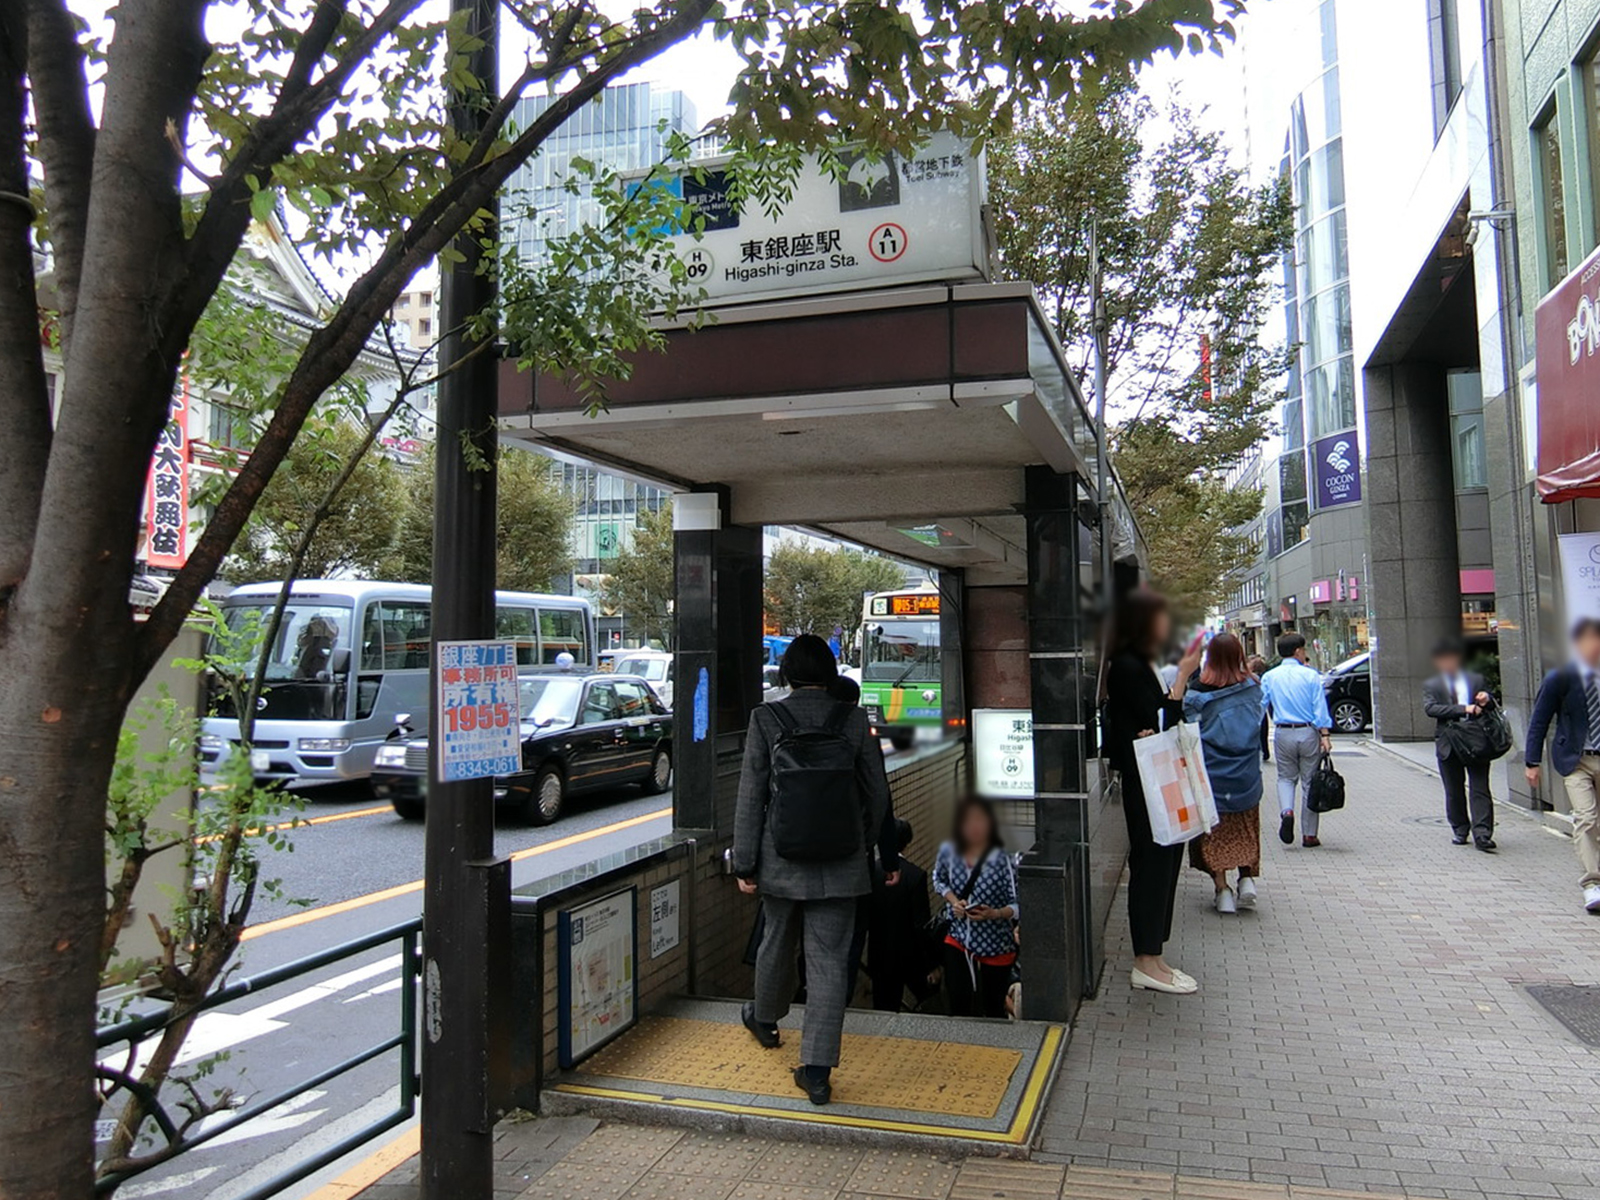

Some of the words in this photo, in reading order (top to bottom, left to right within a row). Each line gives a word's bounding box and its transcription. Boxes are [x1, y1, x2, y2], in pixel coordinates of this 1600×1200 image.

[883, 228, 893, 238] A
[740, 229, 842, 264] 東銀座駅
[879, 240, 897, 254] 11
[692, 252, 702, 262] H
[687, 263, 708, 278] 09
[725, 259, 825, 282] Higashi-ginza
[830, 254, 859, 269] Sta.
[1567, 287, 1600, 366] BON
[1325, 472, 1355, 488] COCON
[1329, 483, 1350, 494] GINZA
[446, 702, 510, 732] 1955
